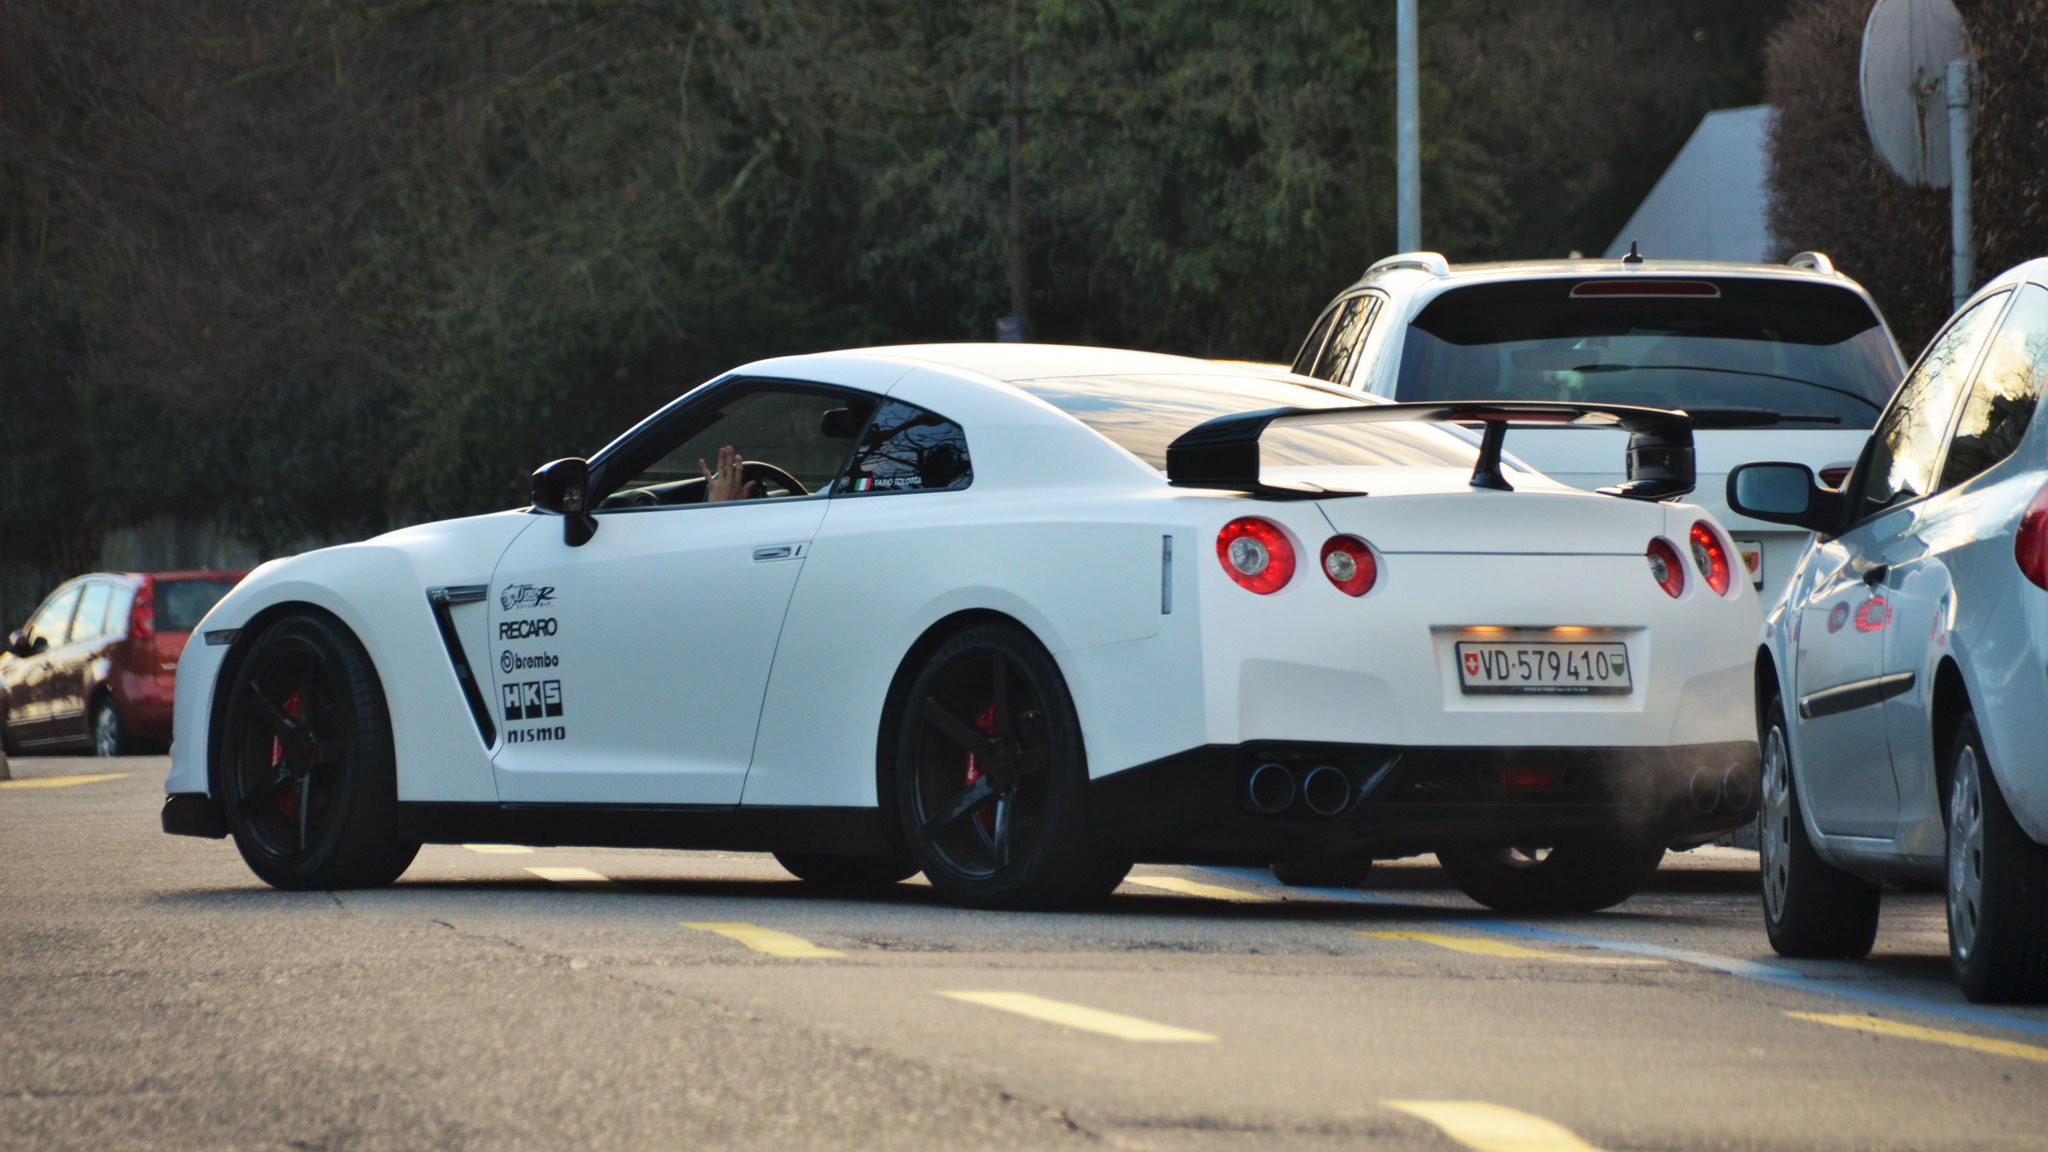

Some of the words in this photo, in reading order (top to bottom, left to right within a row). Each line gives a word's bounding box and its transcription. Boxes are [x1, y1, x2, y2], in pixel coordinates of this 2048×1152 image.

[499, 618, 558, 640] RECARO
[515, 652, 559, 669] brembo
[503, 680, 563, 715] HKS
[508, 727, 566, 743] nismo
